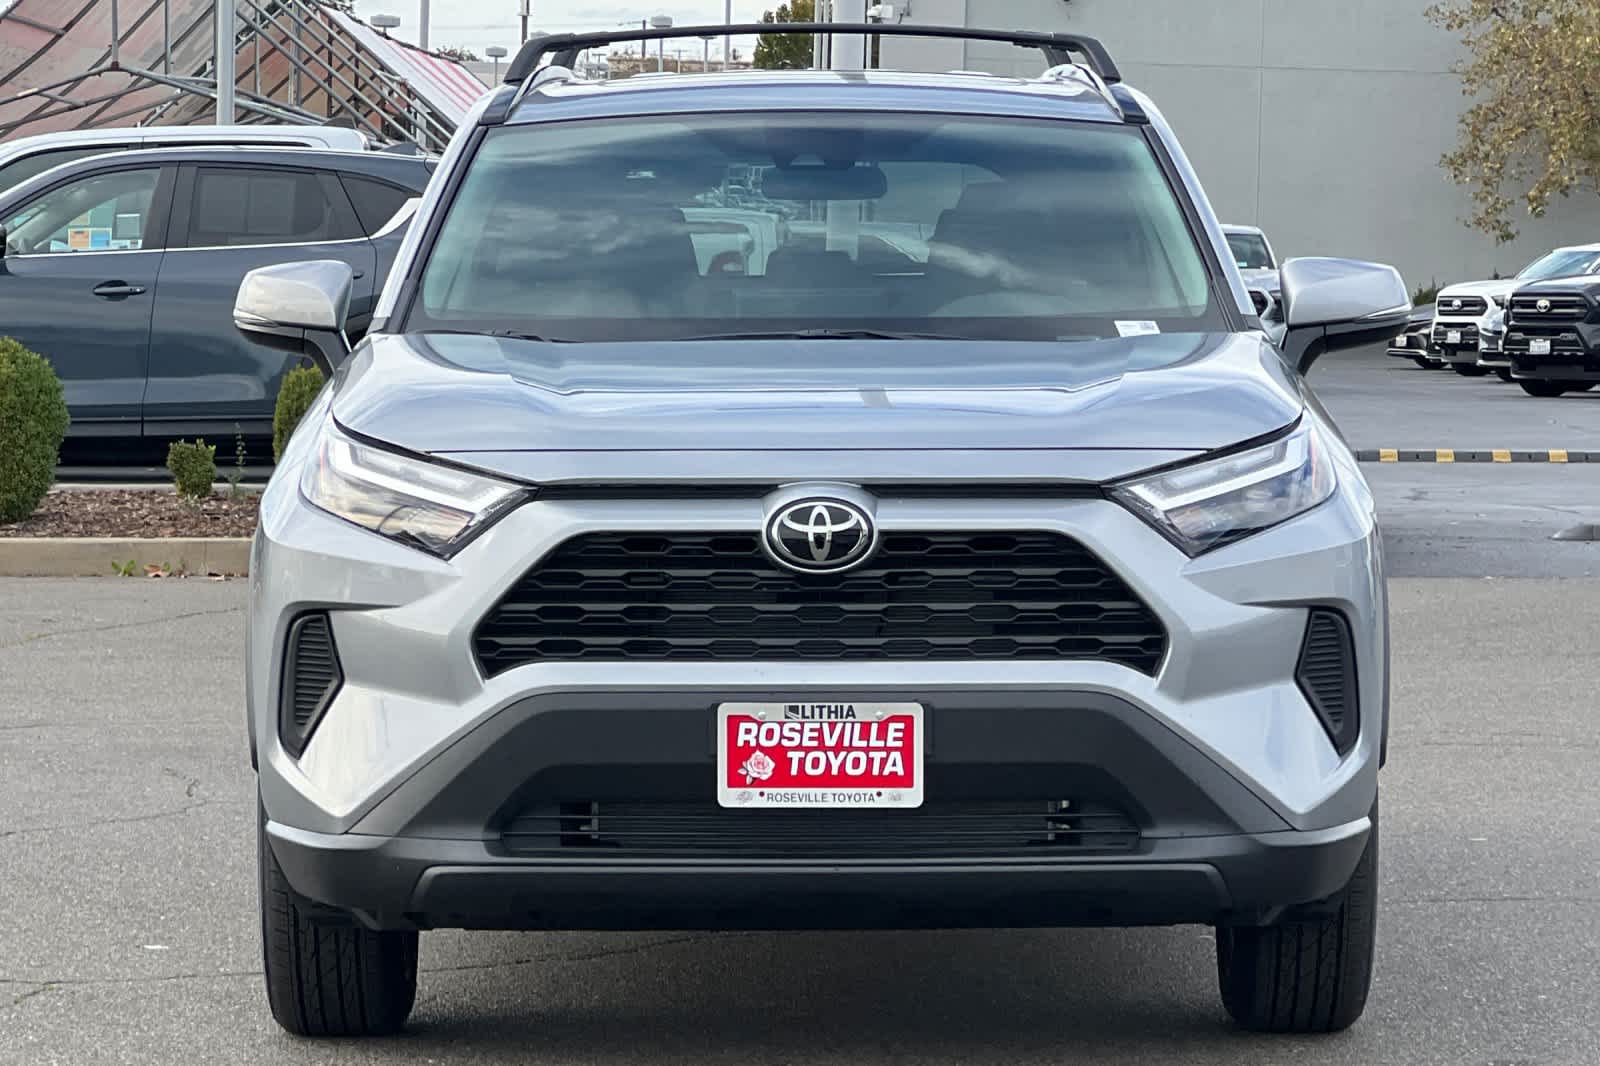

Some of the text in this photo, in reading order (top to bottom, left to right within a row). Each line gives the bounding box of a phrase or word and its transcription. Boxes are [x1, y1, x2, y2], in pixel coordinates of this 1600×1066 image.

[801, 705, 856, 719] LITHIA
[737, 722, 905, 748] ROSEVILLE
[787, 751, 904, 776] TOYOTA
[767, 792, 876, 803] ROSEVILLE TOYOTA
